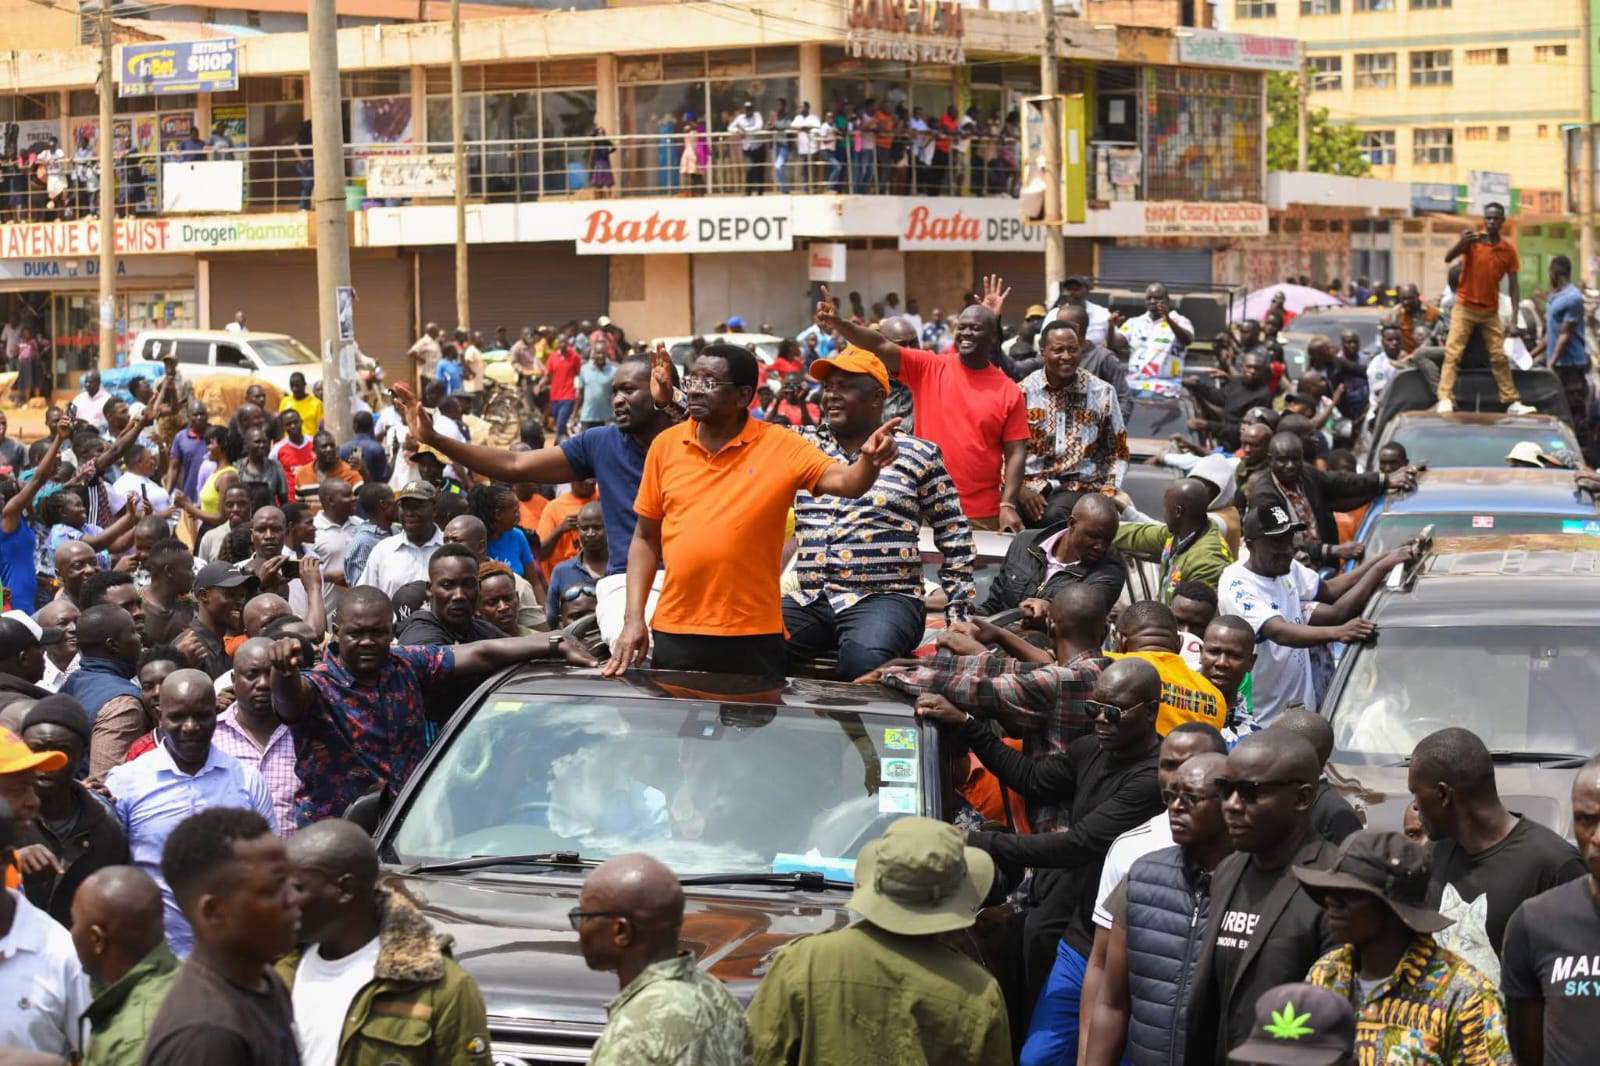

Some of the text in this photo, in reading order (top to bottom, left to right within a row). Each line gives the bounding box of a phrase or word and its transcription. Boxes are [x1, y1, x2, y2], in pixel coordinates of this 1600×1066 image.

[187, 53, 233, 73] SHOP
[0, 221, 169, 257] AYENJE CEMIST
[580, 208, 788, 244] Bata DEPOT
[904, 205, 981, 241] Bata
[24, 261, 60, 276] DUKA
